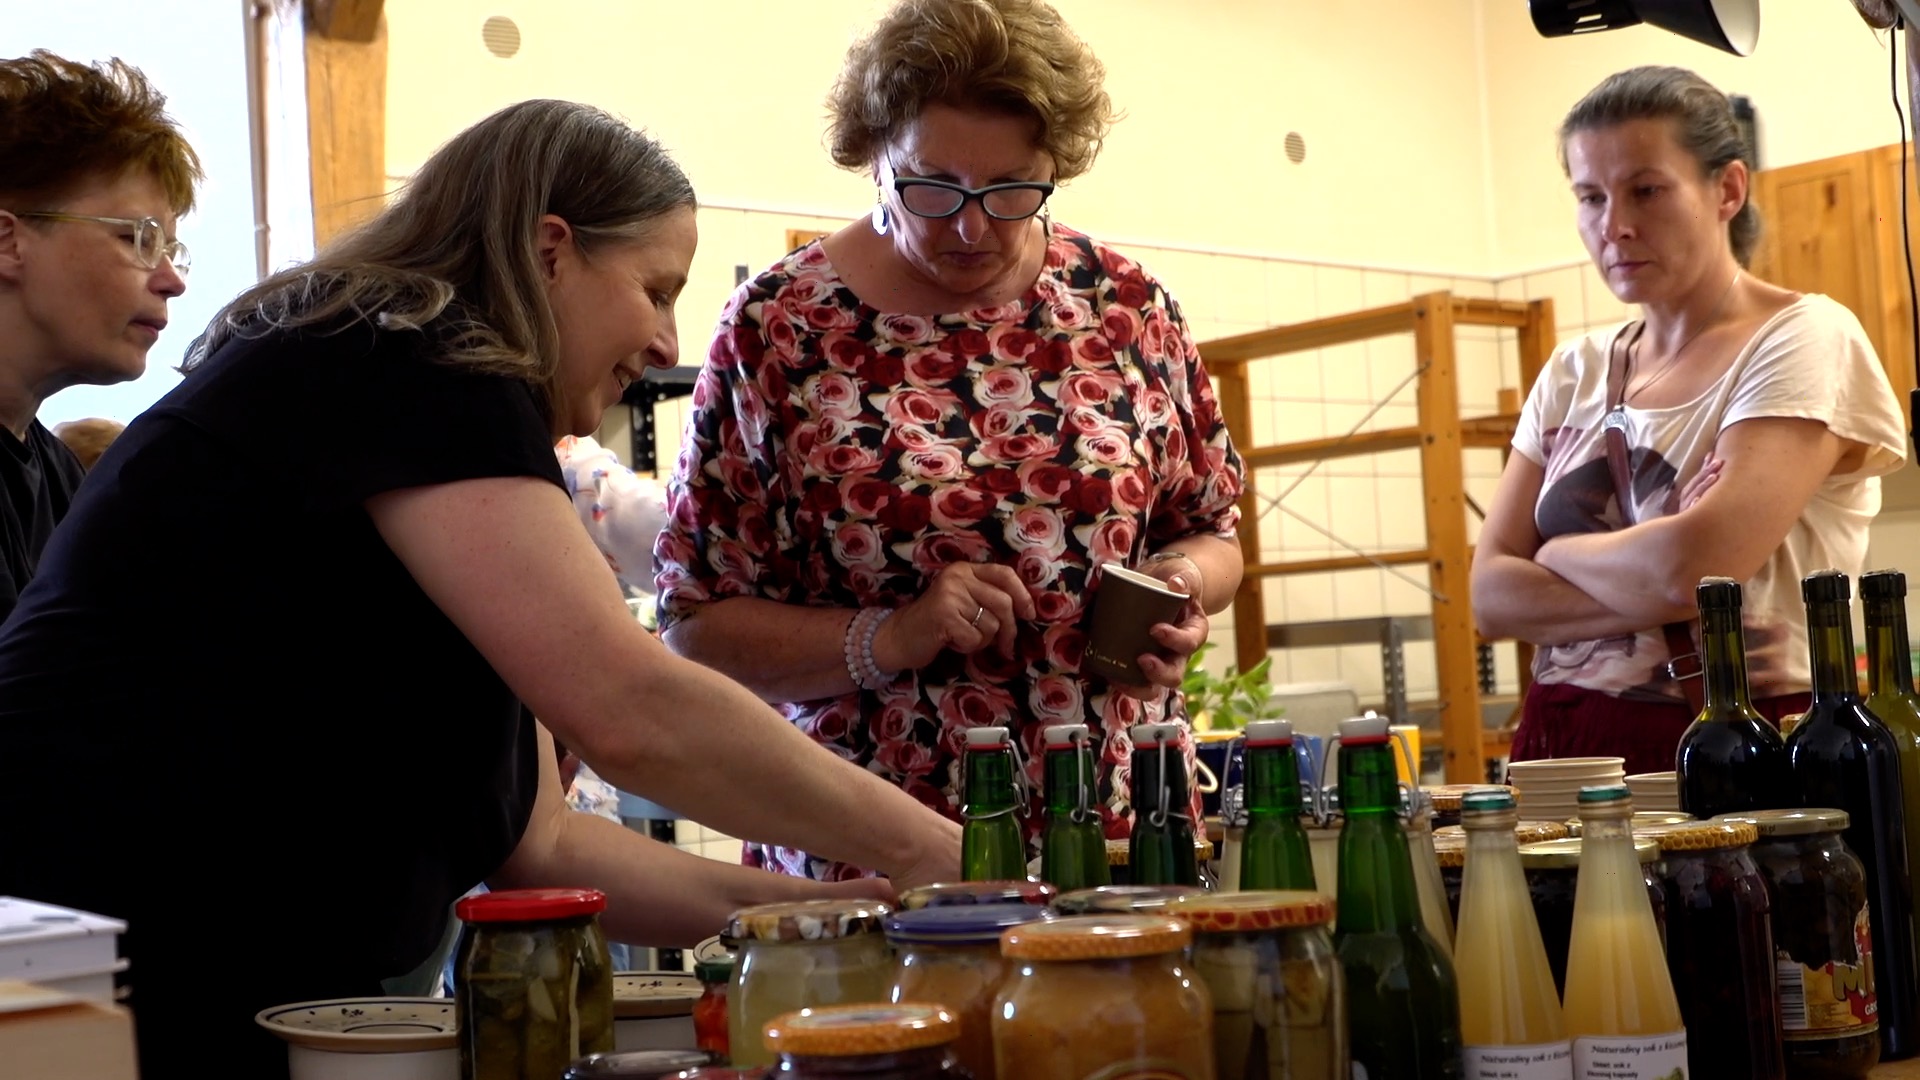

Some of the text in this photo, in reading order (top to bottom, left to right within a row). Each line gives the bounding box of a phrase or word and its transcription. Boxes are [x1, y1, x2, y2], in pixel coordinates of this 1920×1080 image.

[1591, 1045, 1640, 1056] Naturalny
[1643, 1043, 1656, 1052] sok
[1480, 1055, 1530, 1066] Naturalny
[1533, 1053, 1545, 1062] sok
